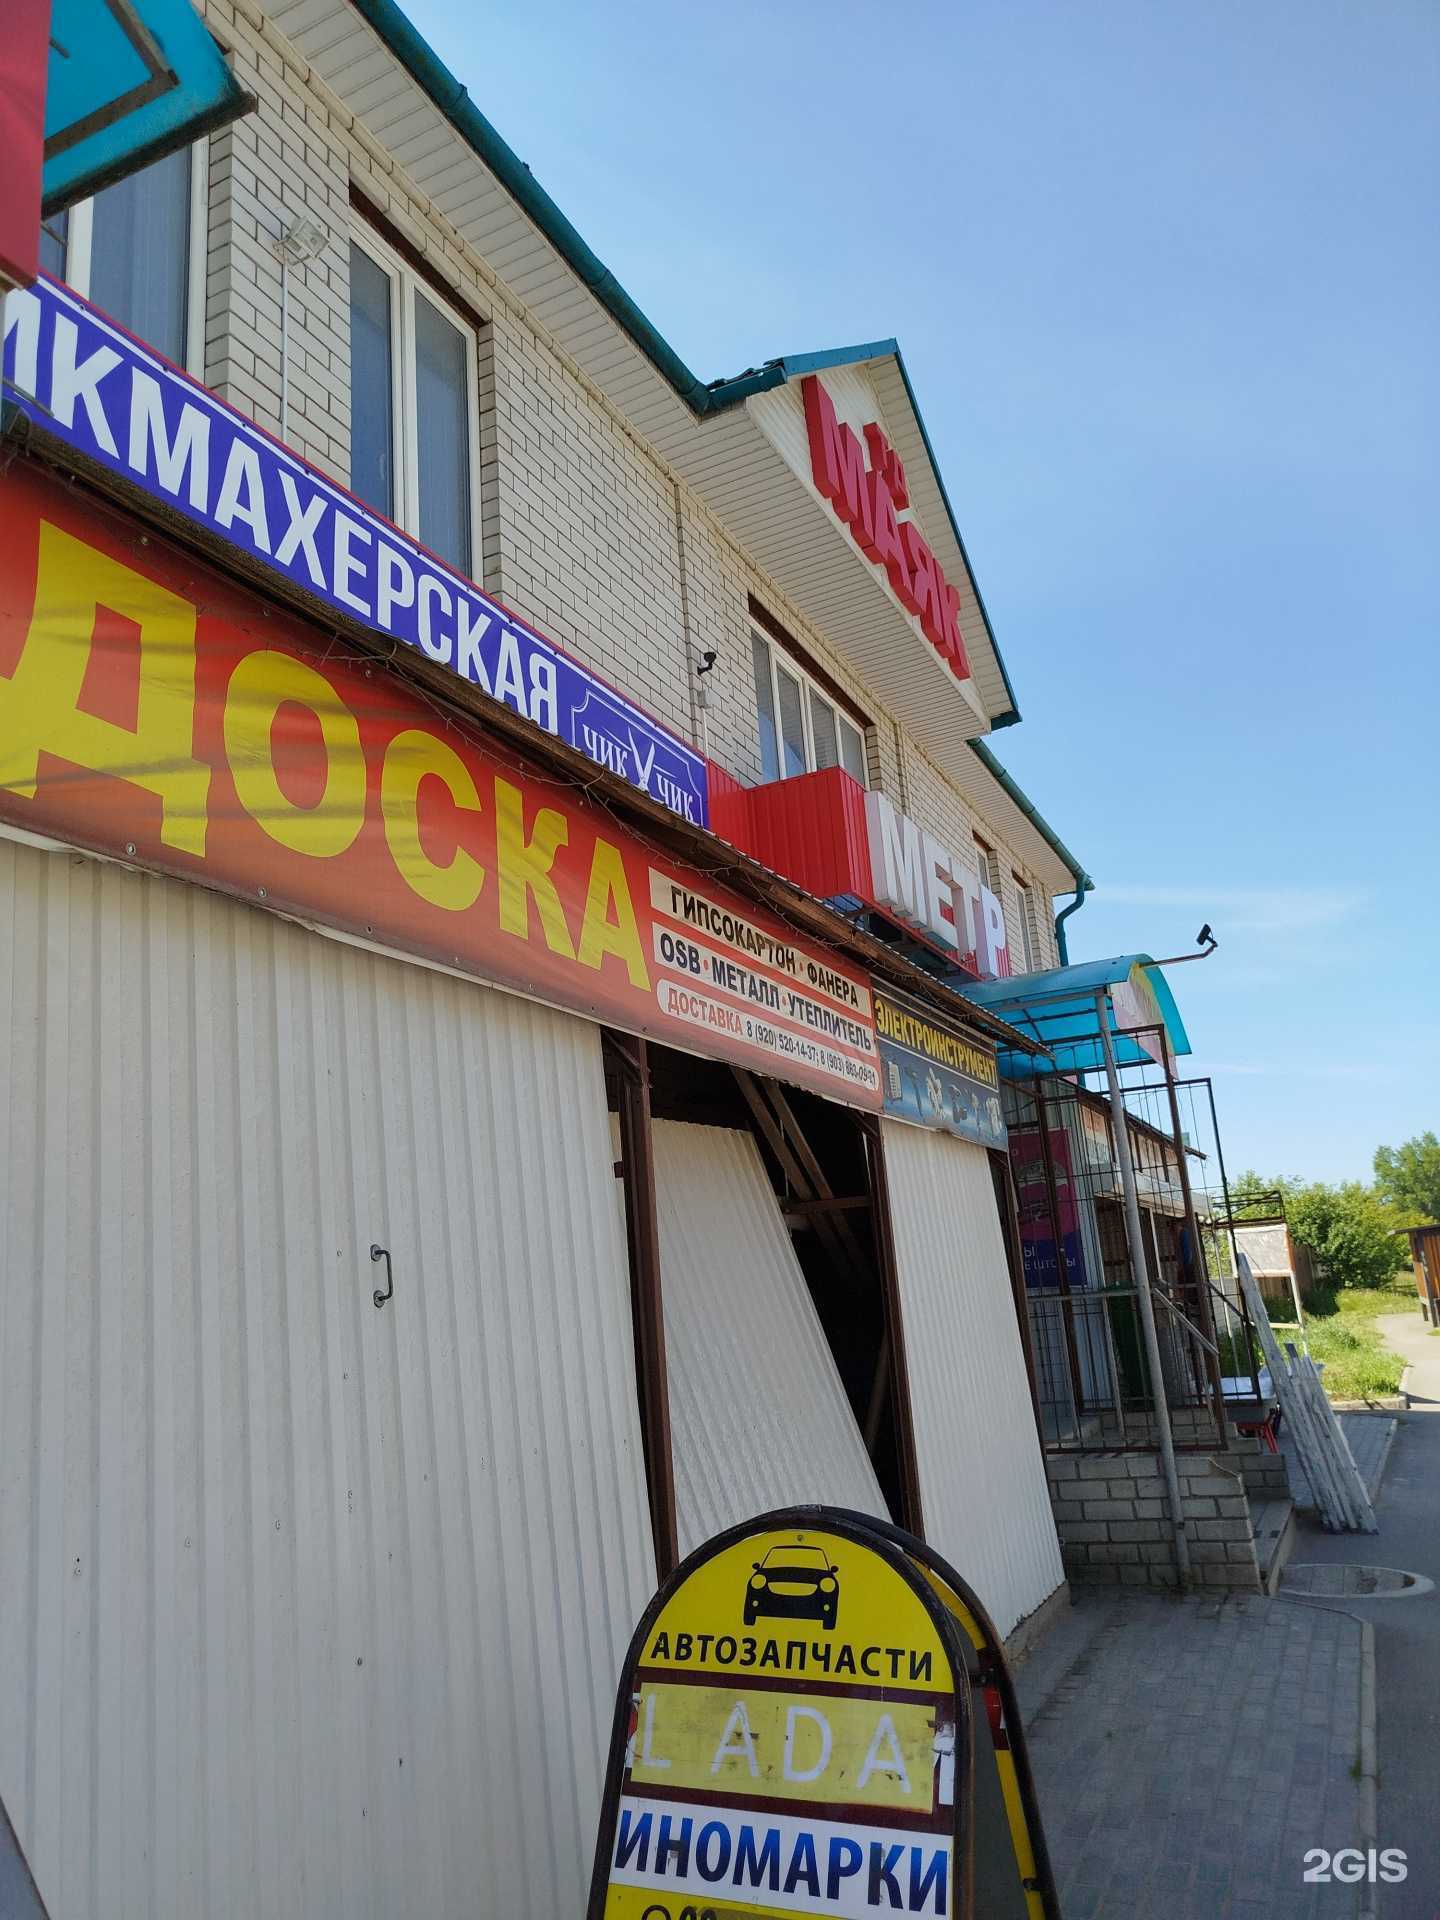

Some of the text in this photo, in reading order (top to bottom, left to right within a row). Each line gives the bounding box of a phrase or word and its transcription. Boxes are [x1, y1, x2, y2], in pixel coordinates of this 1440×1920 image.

[801, 375, 972, 681] МАЯК
[0, 518, 652, 992] ДОСКА
[582, 723, 695, 827] ЧИК ЧИК
[864, 791, 1008, 978] МЕТР
[660, 932, 872, 1051] OSB МЕТАЛЛ УТЕПЛИТЕЛЬ
[670, 884, 859, 1008] ГИПСОКАРТОН ФАНЕРА
[668, 987, 743, 1036] ДОСТАВКА
[746, 1020, 753, 1038] 8
[755, 1023, 777, 1052] (920)
[875, 998, 996, 1086] ЭЛЕКТРОИНСТРУМЕНТ
[650, 1631, 933, 1682] АВТОЗАПЧАСТИ
[614, 1809, 949, 1916] ИНОМАРКИ
